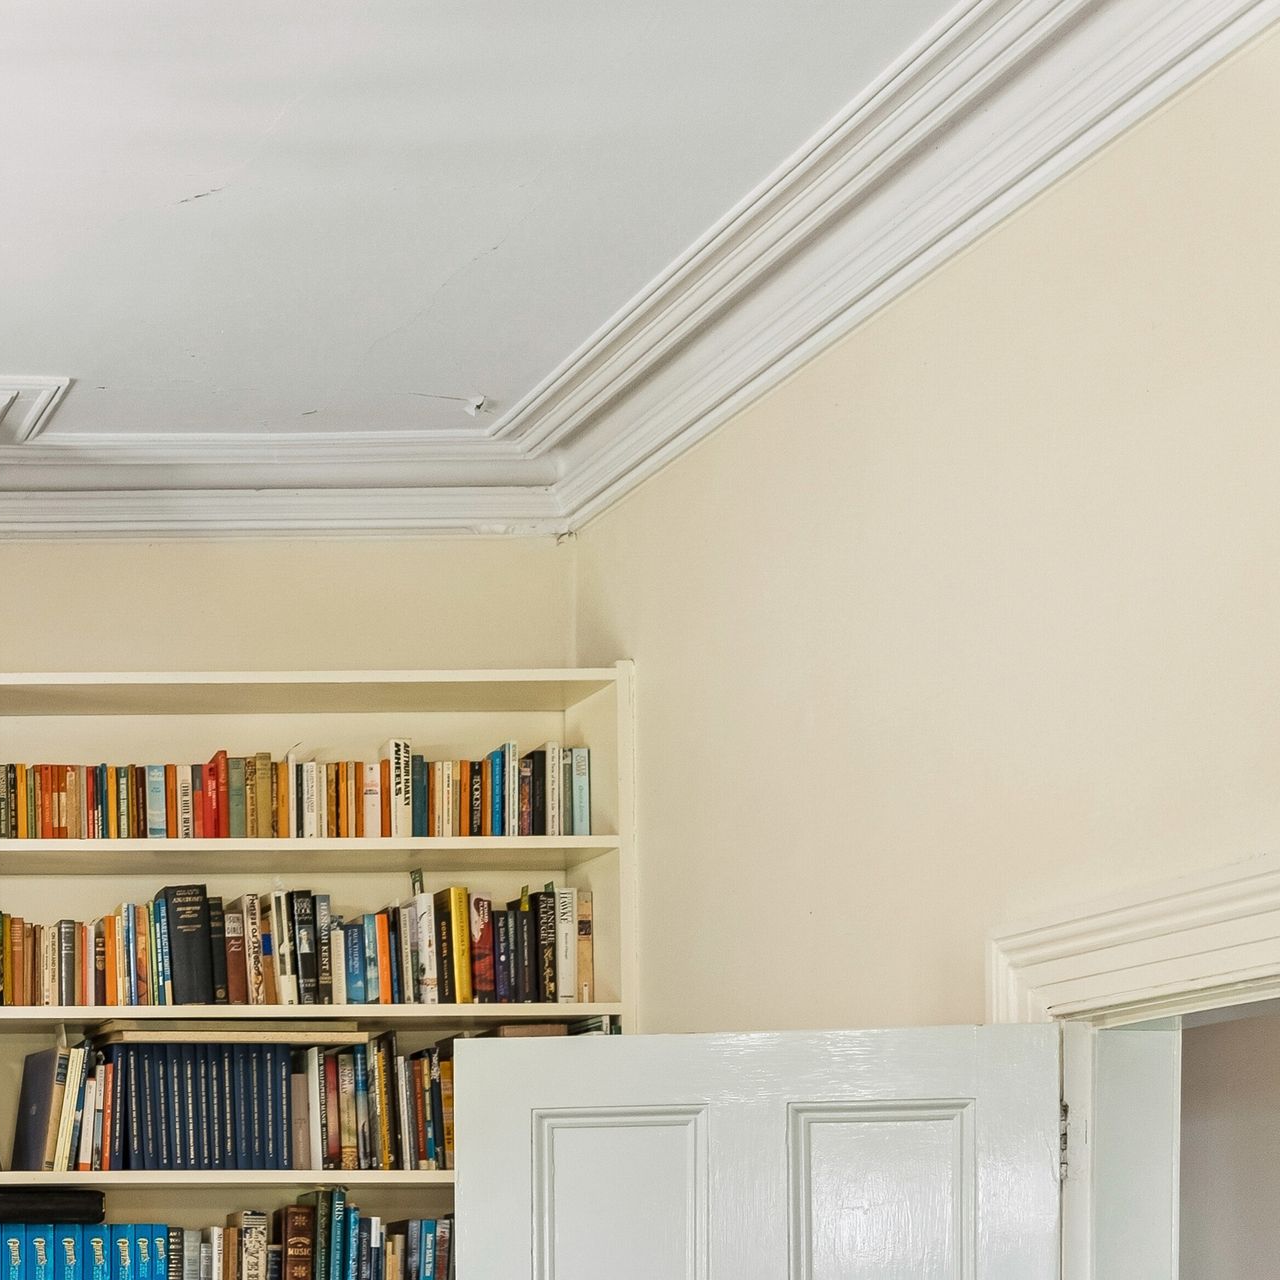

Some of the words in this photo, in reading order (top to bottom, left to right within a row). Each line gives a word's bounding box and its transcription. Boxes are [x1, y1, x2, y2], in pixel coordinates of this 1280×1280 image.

[394, 742, 402, 797] WHEELS
[182, 817, 191, 839] REPOR
[547, 897, 555, 944] BLANCHE
[559, 892, 569, 922] HAWKE
[320, 902, 329, 943] HANNAH
[321, 946, 329, 971] KENT
[335, 1200, 344, 1221] IRIS
